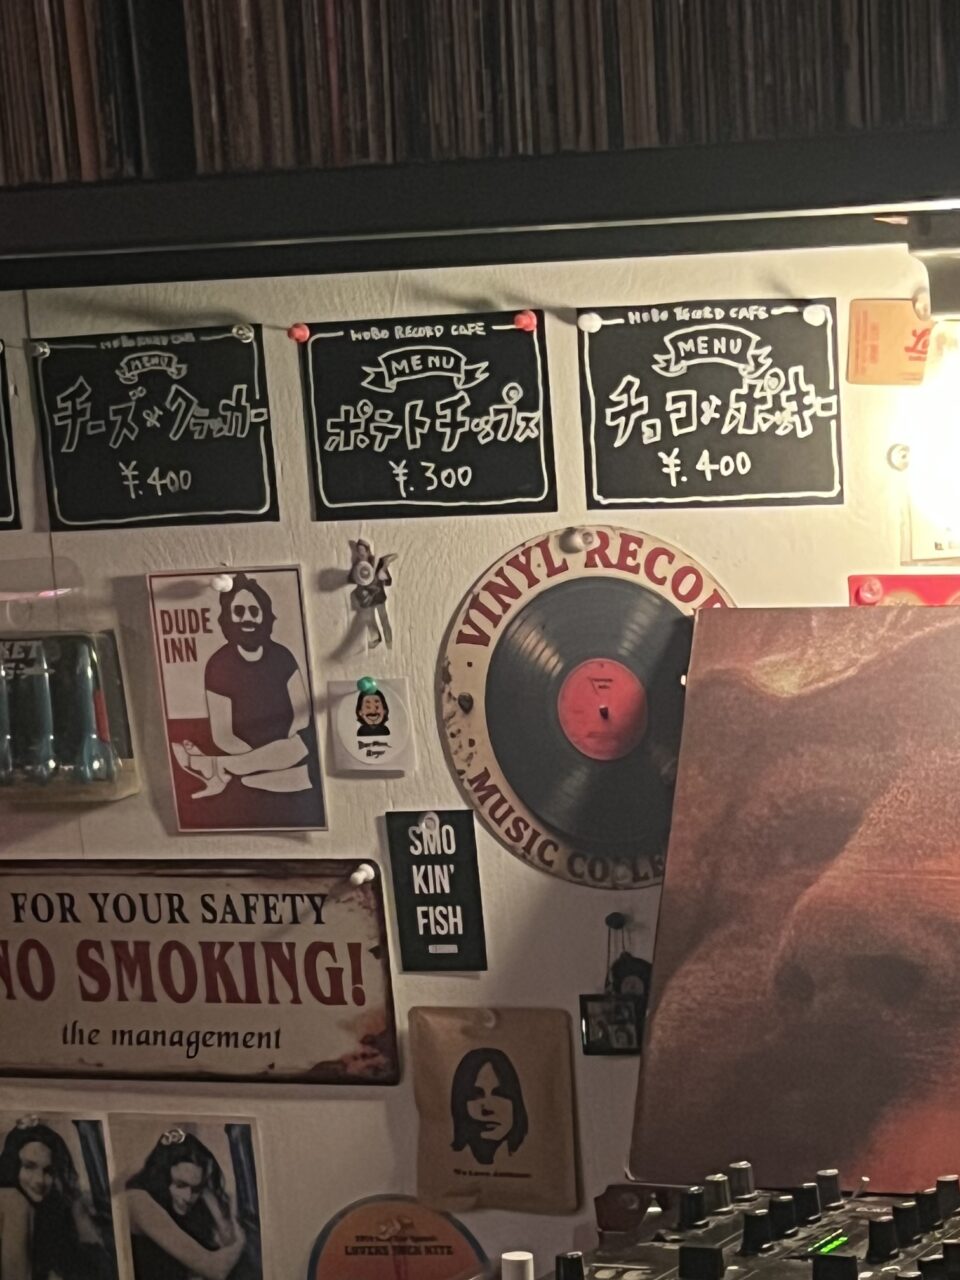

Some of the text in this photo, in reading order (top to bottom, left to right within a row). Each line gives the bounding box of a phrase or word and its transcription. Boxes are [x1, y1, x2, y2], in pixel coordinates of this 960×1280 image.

[395, 325, 443, 339] RECORD
[451, 322, 486, 336] CAFE
[677, 336, 743, 357] MENU
[391, 355, 455, 375] MENU
[456, 538, 569, 647] VINYL
[160, 608, 213, 635] DUDE
[163, 637, 198, 664] INN
[468, 768, 558, 868] MUSIC
[408, 825, 456, 855] SMO
[412, 864, 454, 894] KIN'
[11, 893, 328, 925] FOR YOUR SAFETY
[416, 905, 463, 935] FISH
[76, 939, 366, 1007] SMOKING!
[62, 1020, 281, 1058] the management
